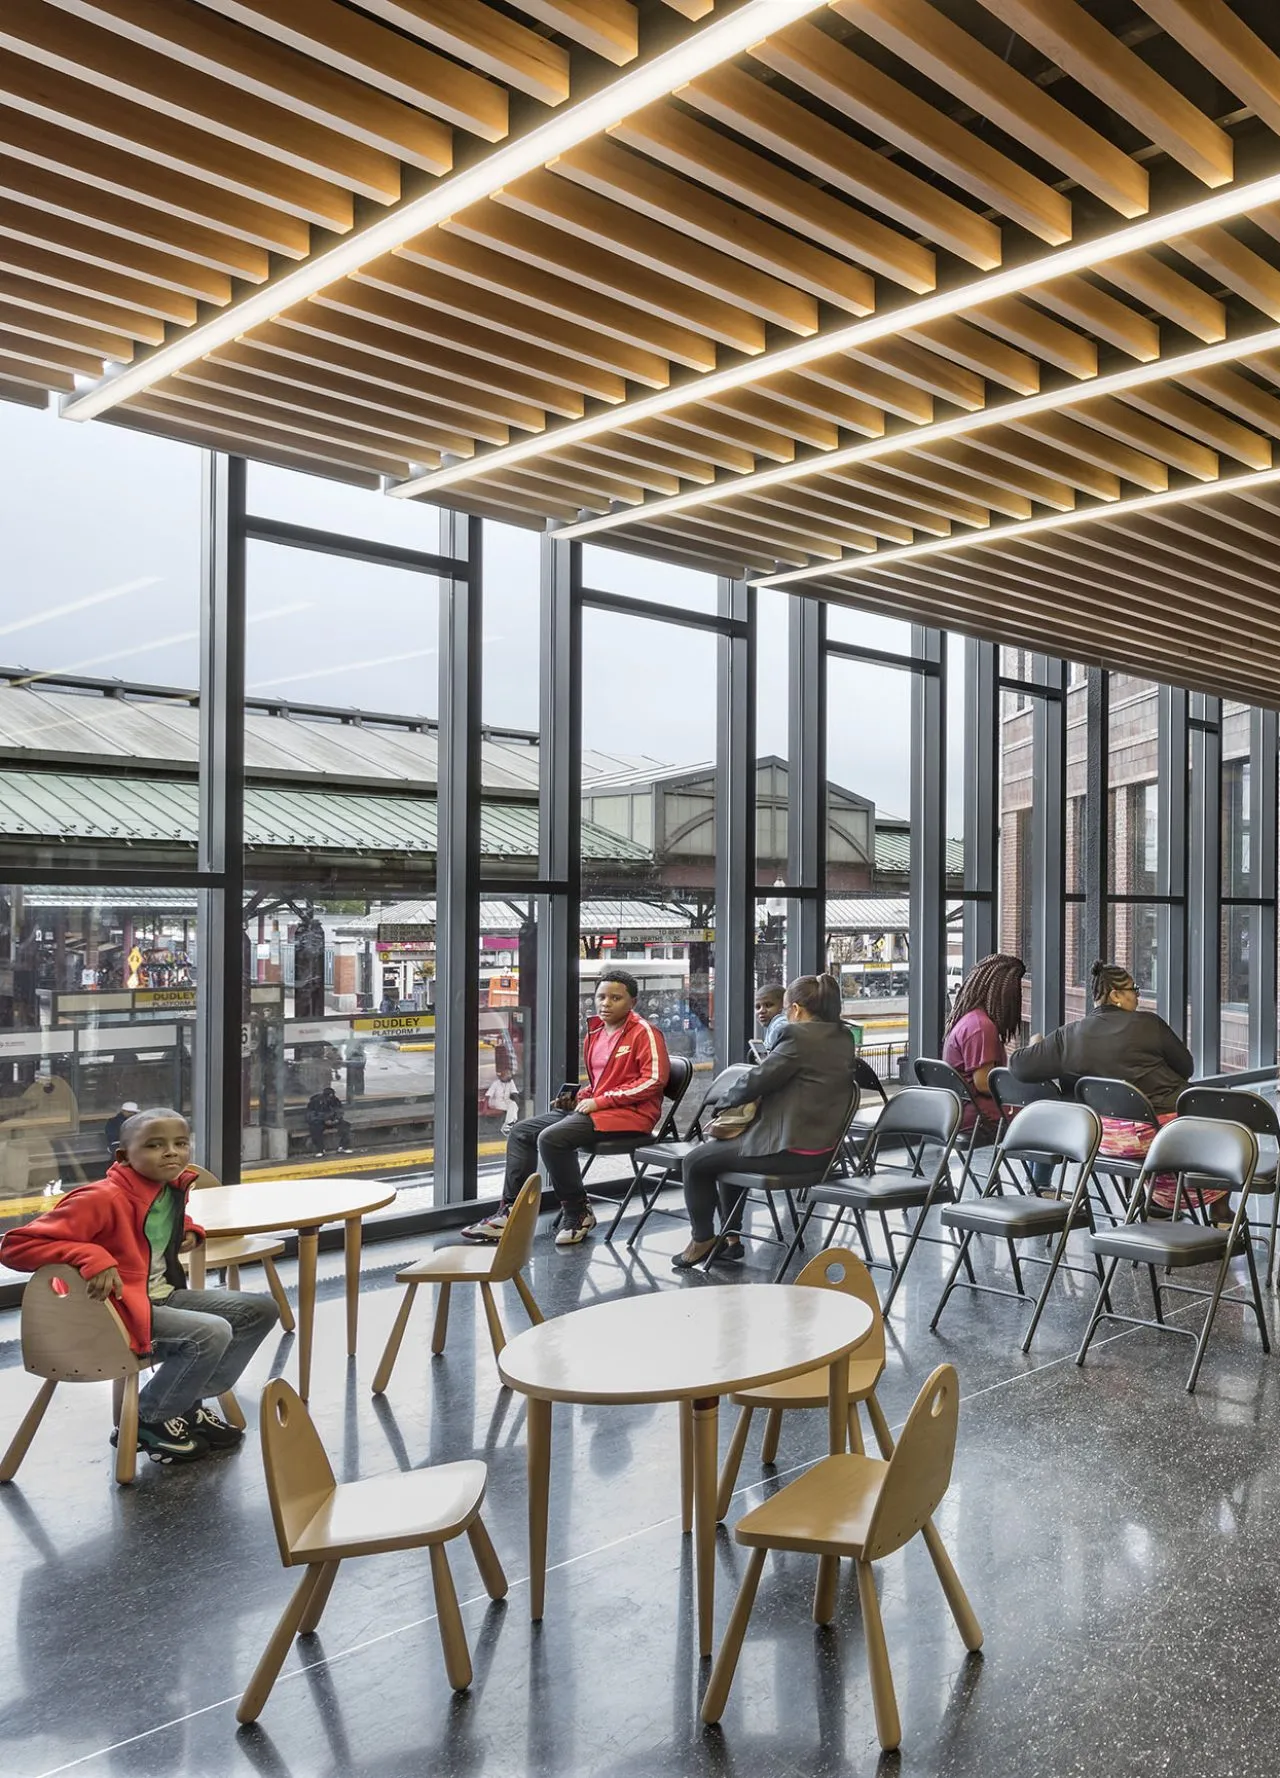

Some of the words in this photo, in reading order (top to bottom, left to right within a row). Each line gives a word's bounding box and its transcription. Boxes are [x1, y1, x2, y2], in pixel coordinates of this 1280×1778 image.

[705, 931, 712, 941] F
[153, 991, 195, 1001] DUDLEY
[373, 1017, 420, 1029] DUDLEY
[372, 1028, 413, 1036] PLATFORM
